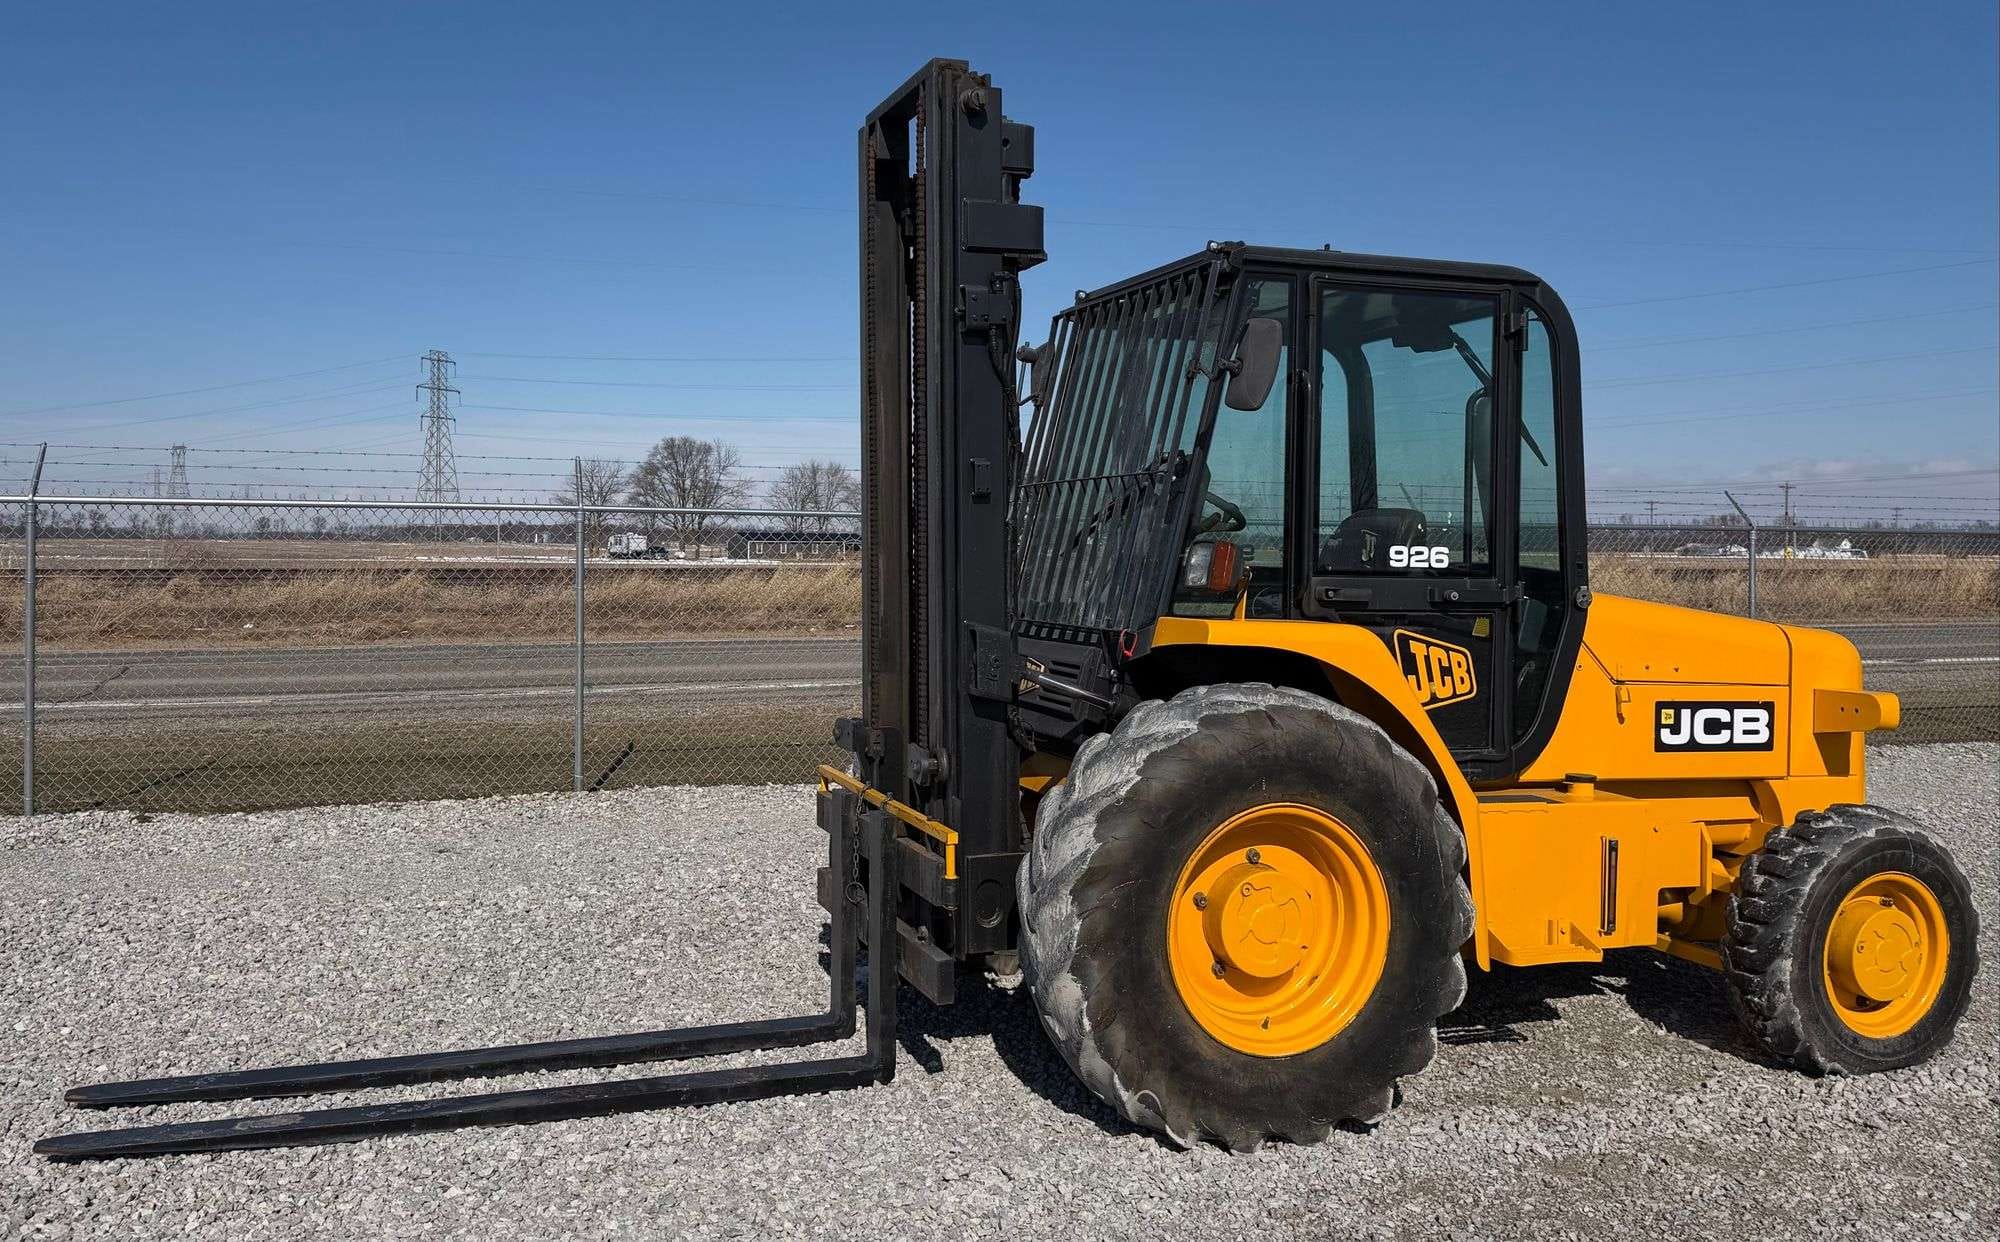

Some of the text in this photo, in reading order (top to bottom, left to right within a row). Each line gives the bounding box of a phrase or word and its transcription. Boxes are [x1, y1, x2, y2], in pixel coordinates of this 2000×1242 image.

[1389, 545, 1450, 569] 926
[1407, 639, 1471, 704] JCB
[1660, 708, 1770, 745] JCB
